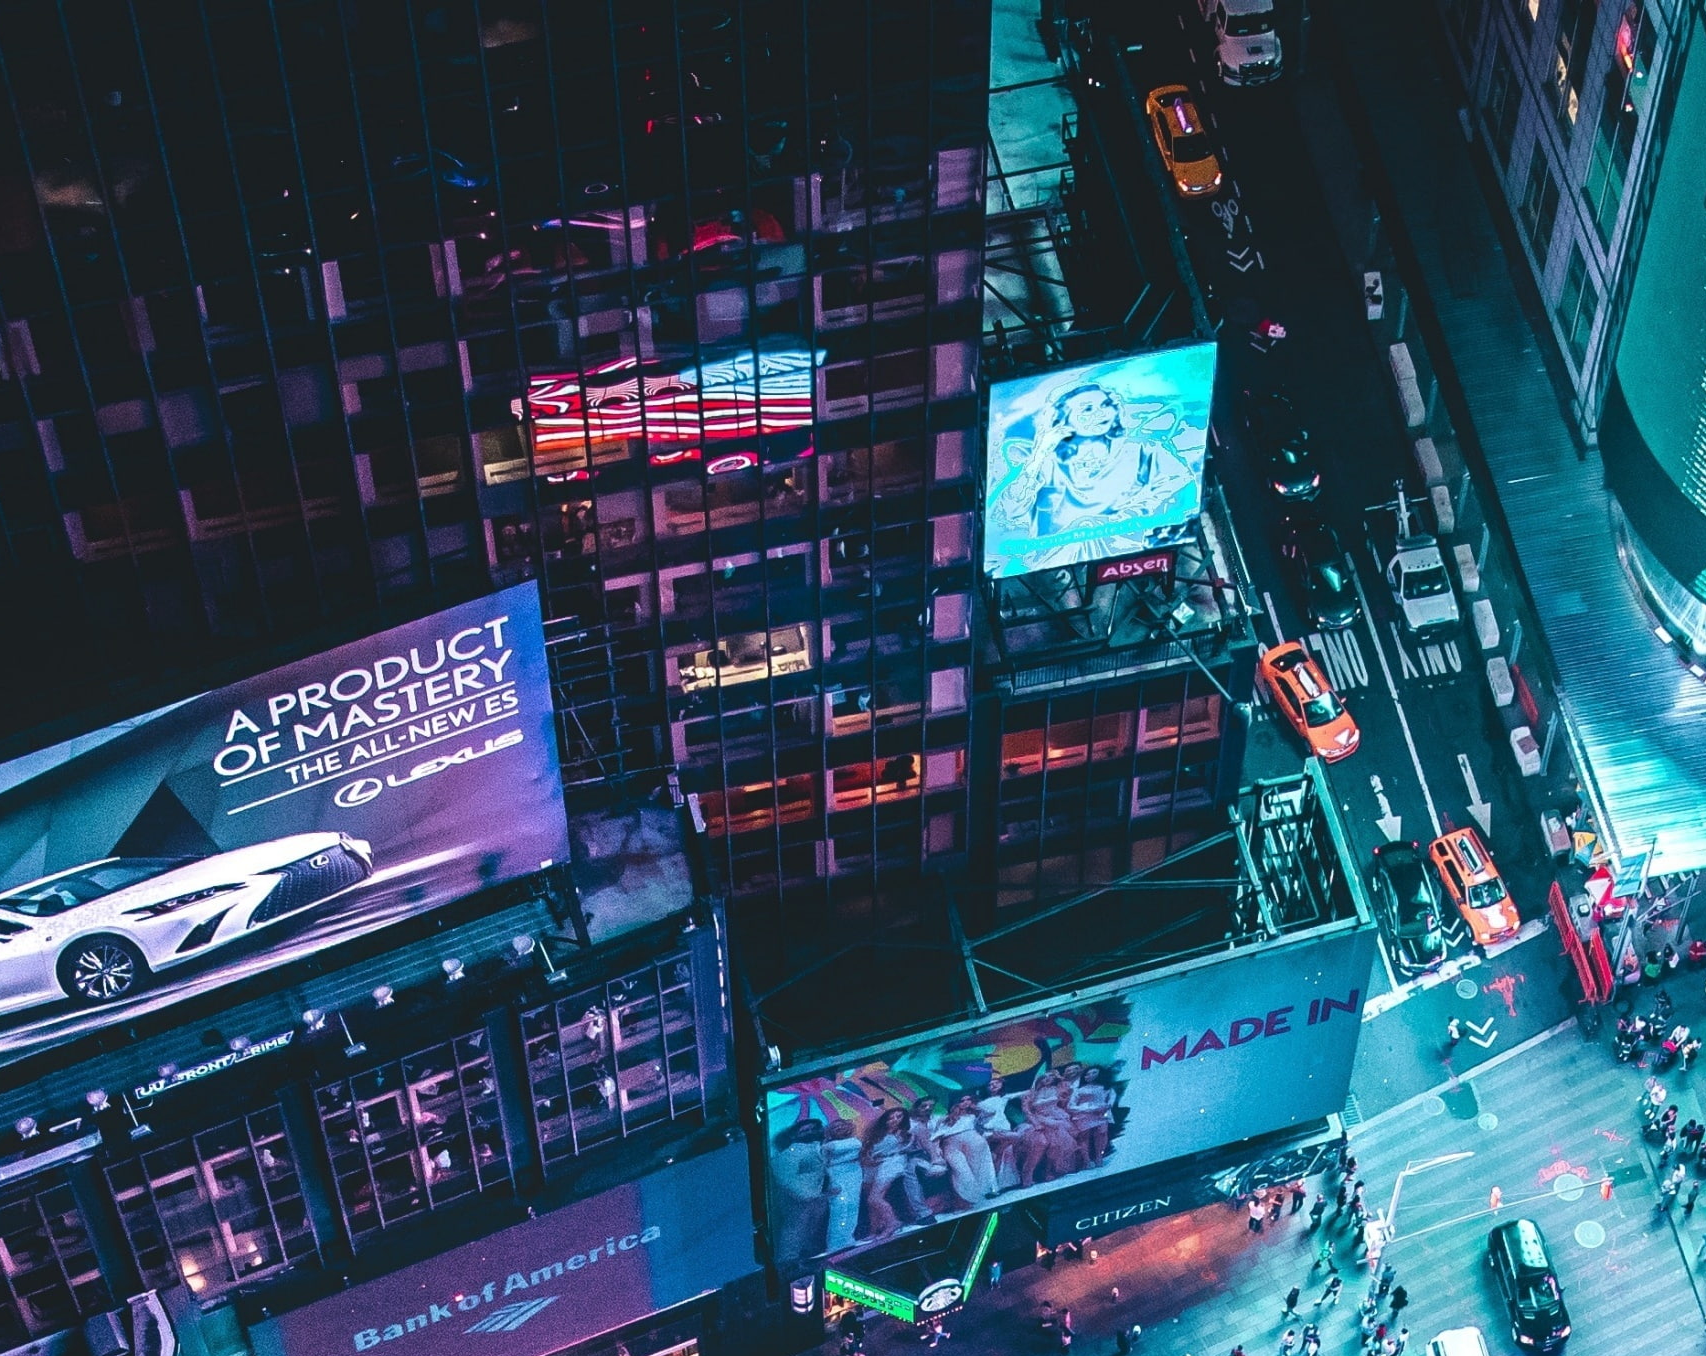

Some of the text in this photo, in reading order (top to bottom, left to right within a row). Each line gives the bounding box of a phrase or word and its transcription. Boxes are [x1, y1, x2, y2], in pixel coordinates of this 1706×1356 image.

[1101, 557, 1169, 579] Absen
[213, 650, 512, 781] OF MASTERY
[226, 617, 510, 743] A PRODUCT
[286, 690, 519, 786] THE ALL-NEW ES
[385, 729, 525, 788] LEXUS
[1140, 988, 1361, 1071] MADE IN
[1075, 1195, 1172, 1231] CITIZEN
[352, 1220, 663, 1354] Bank of America
